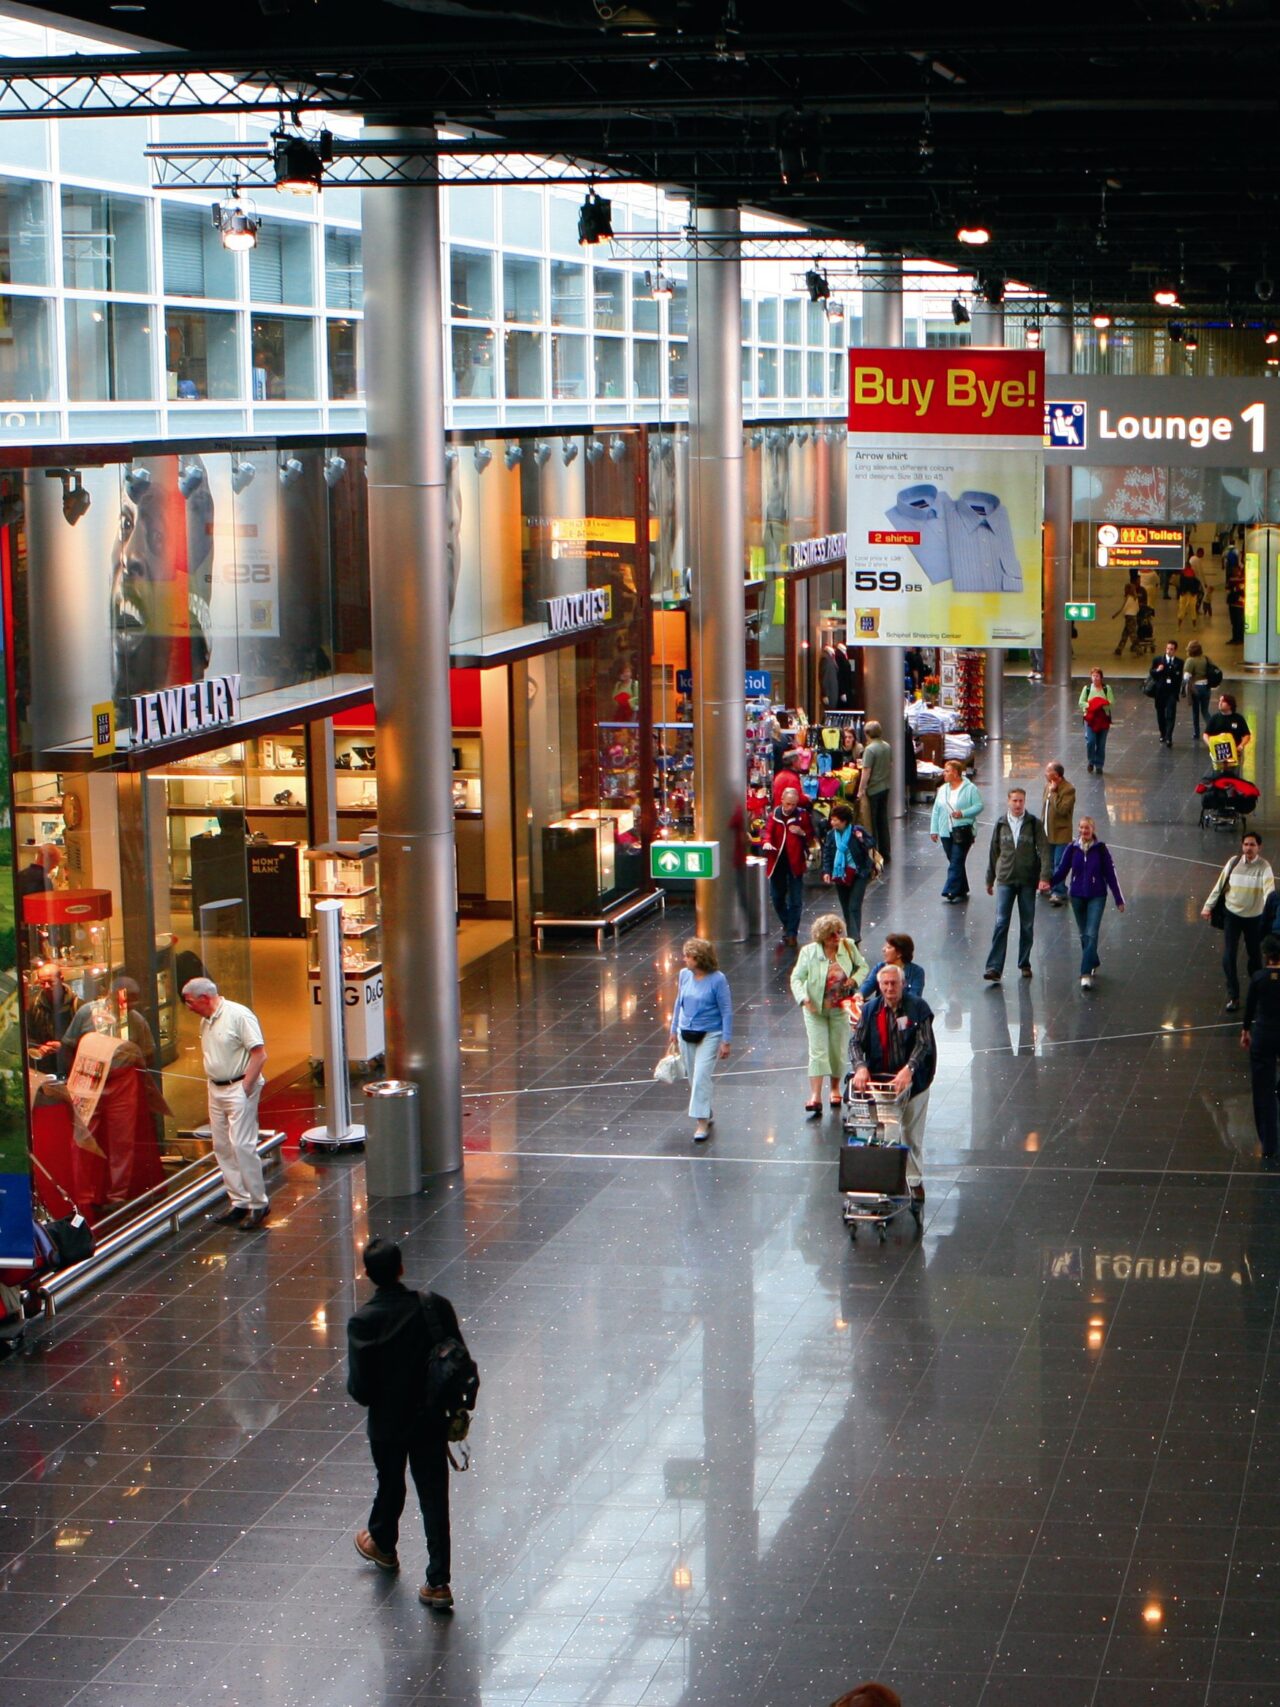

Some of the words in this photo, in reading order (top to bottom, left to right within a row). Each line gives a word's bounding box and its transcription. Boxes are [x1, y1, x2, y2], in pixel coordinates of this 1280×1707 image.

[854, 366, 935, 417] Buy
[946, 368, 1037, 418] Bye!
[1099, 409, 1233, 448] Lounge
[1240, 403, 1265, 453] 1
[855, 451, 884, 460] Arrow
[886, 451, 908, 461] shirt
[874, 533, 883, 543] 2
[885, 533, 914, 543] shirts
[1148, 530, 1183, 541] Toilets
[793, 538, 826, 568] BUSINESS
[854, 571, 923, 593] 59,95
[548, 588, 606, 634] WATCHES
[912, 632, 940, 640] Shopping
[130, 674, 241, 747] JEWELRY
[98, 714, 108, 725] SEE
[99, 724, 109, 734] BUY
[252, 857, 279, 866] MONT
[252, 865, 279, 874] BLANC
[365, 979, 383, 1005] D&G
